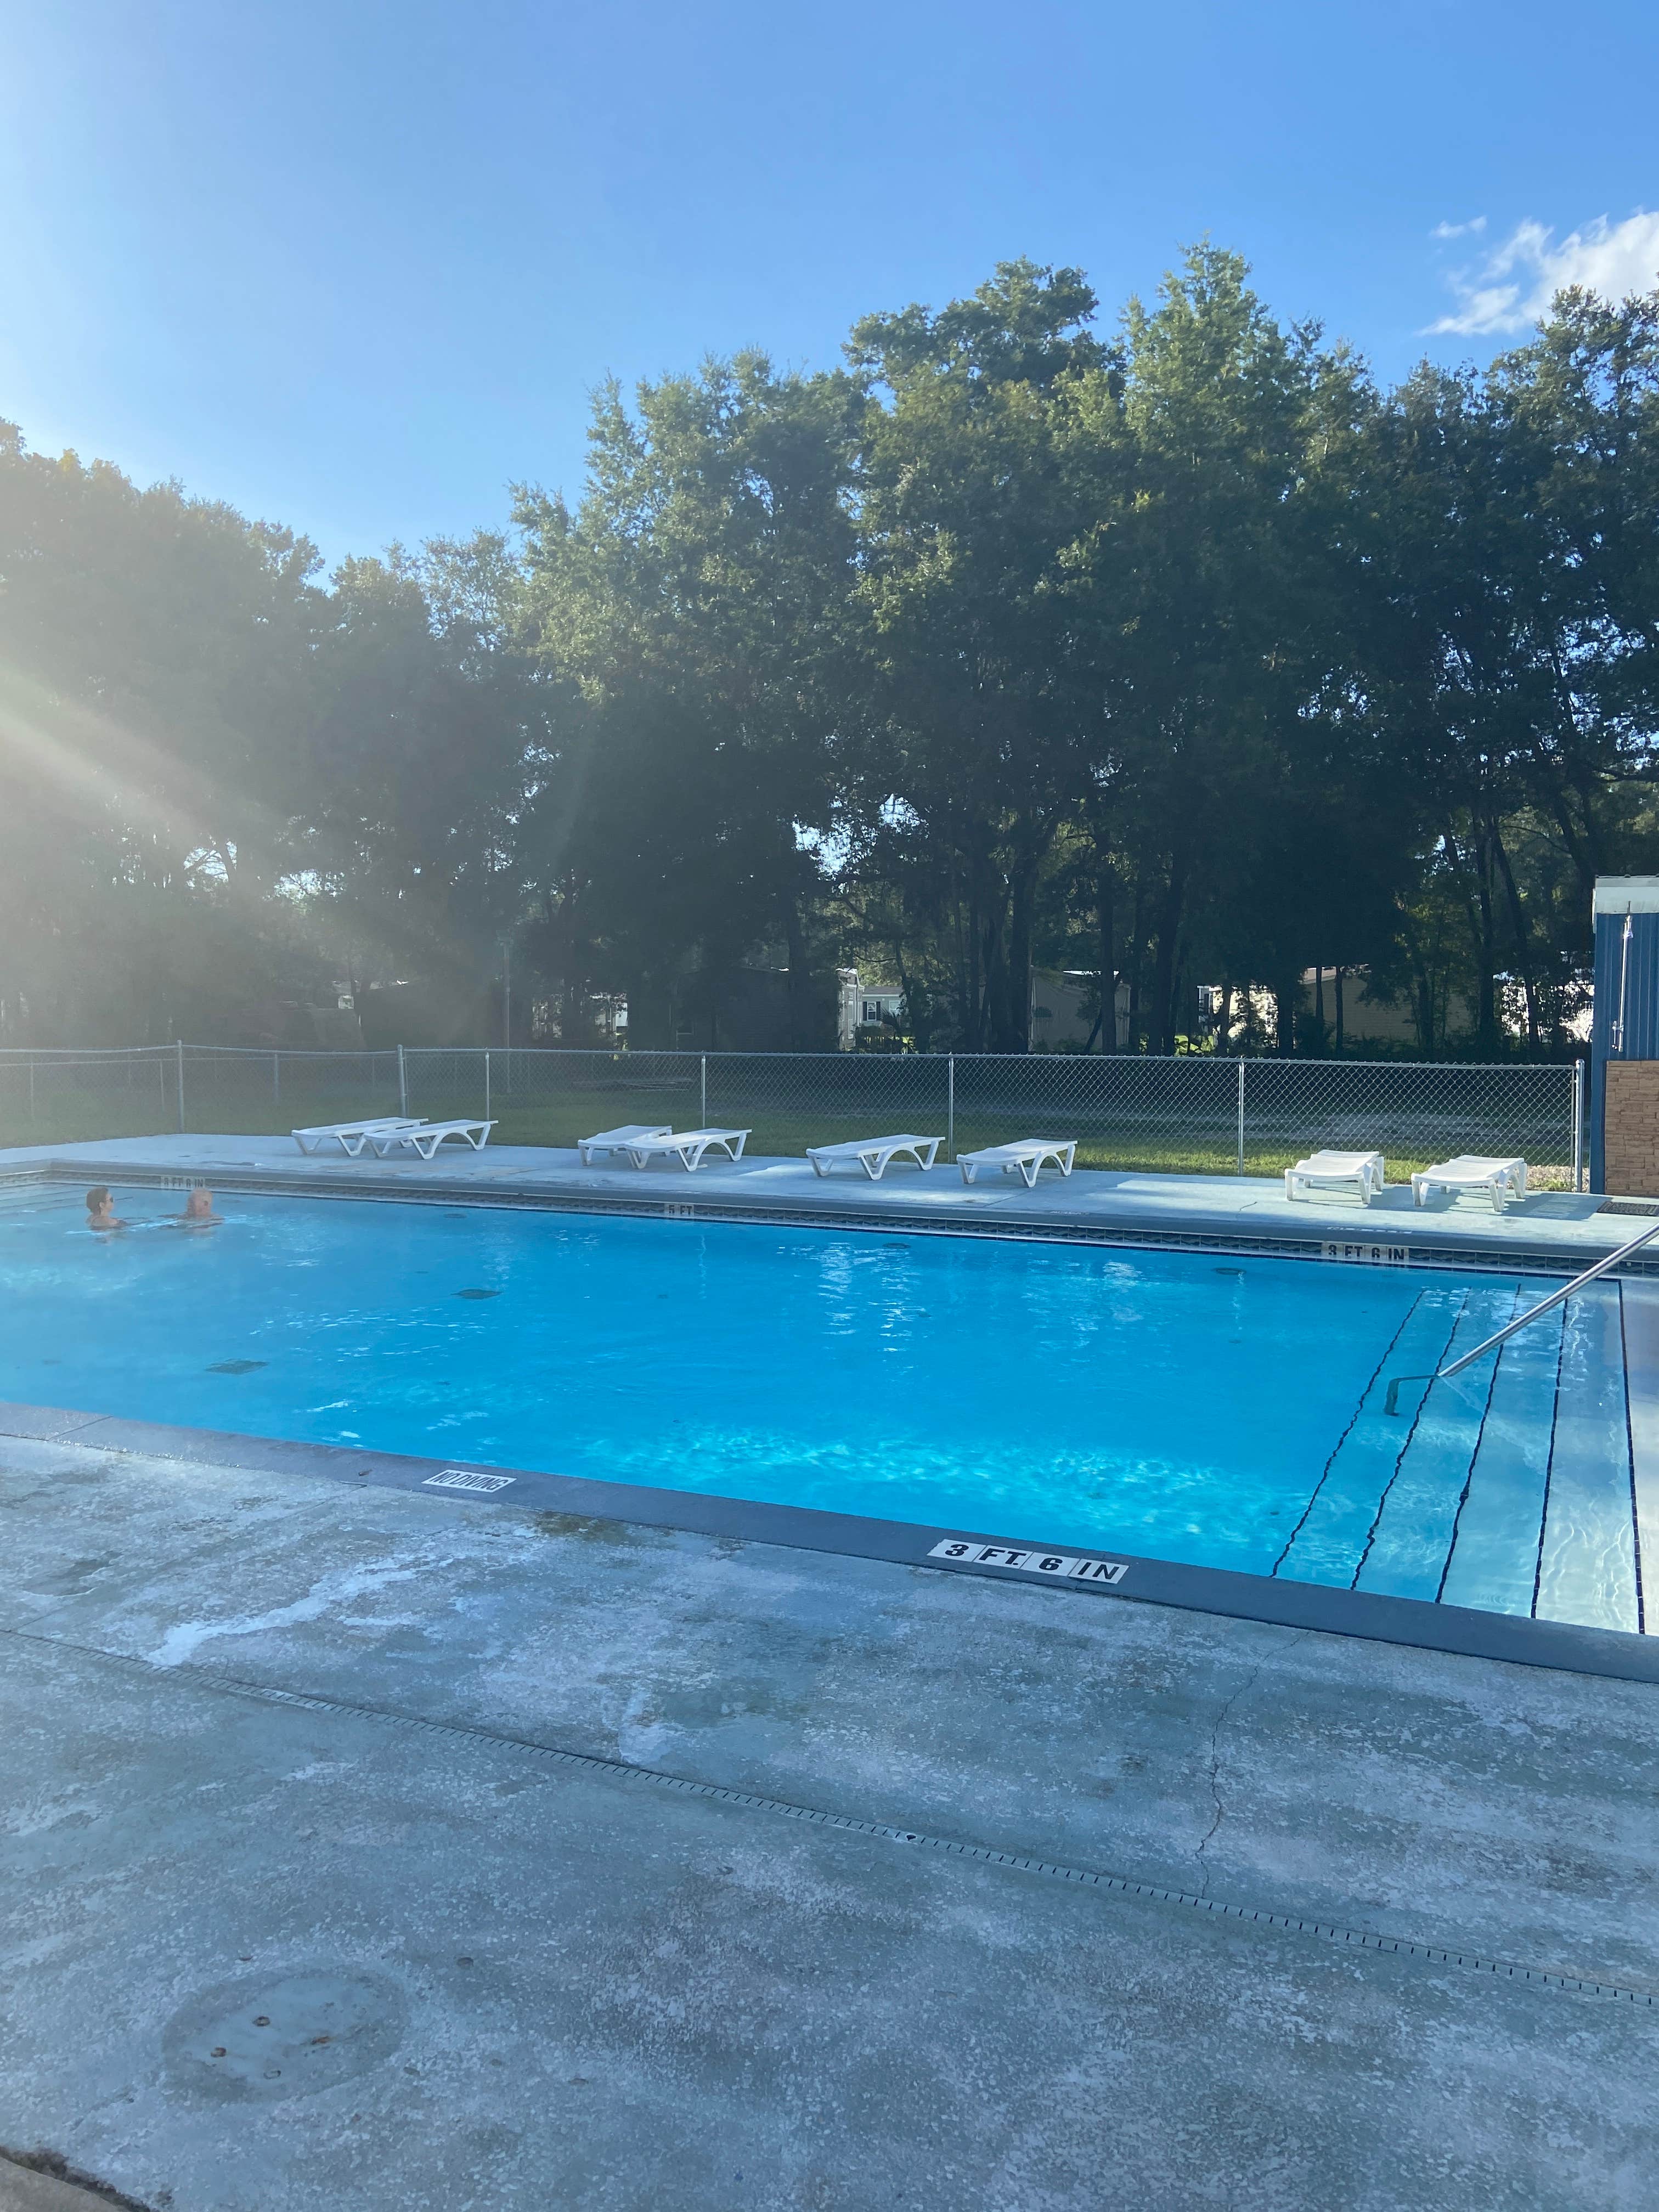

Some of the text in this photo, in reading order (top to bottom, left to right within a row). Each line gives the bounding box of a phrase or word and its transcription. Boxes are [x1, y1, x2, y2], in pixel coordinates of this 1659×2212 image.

[680, 1206, 692, 1215] FT
[1328, 1245, 1404, 1260] 3 FT 6 IN
[430, 1471, 509, 1490] NO DIVING
[945, 1544, 969, 1556] 3
[1039, 1558, 1063, 1570] 6
[1077, 1562, 1119, 1579] IN
